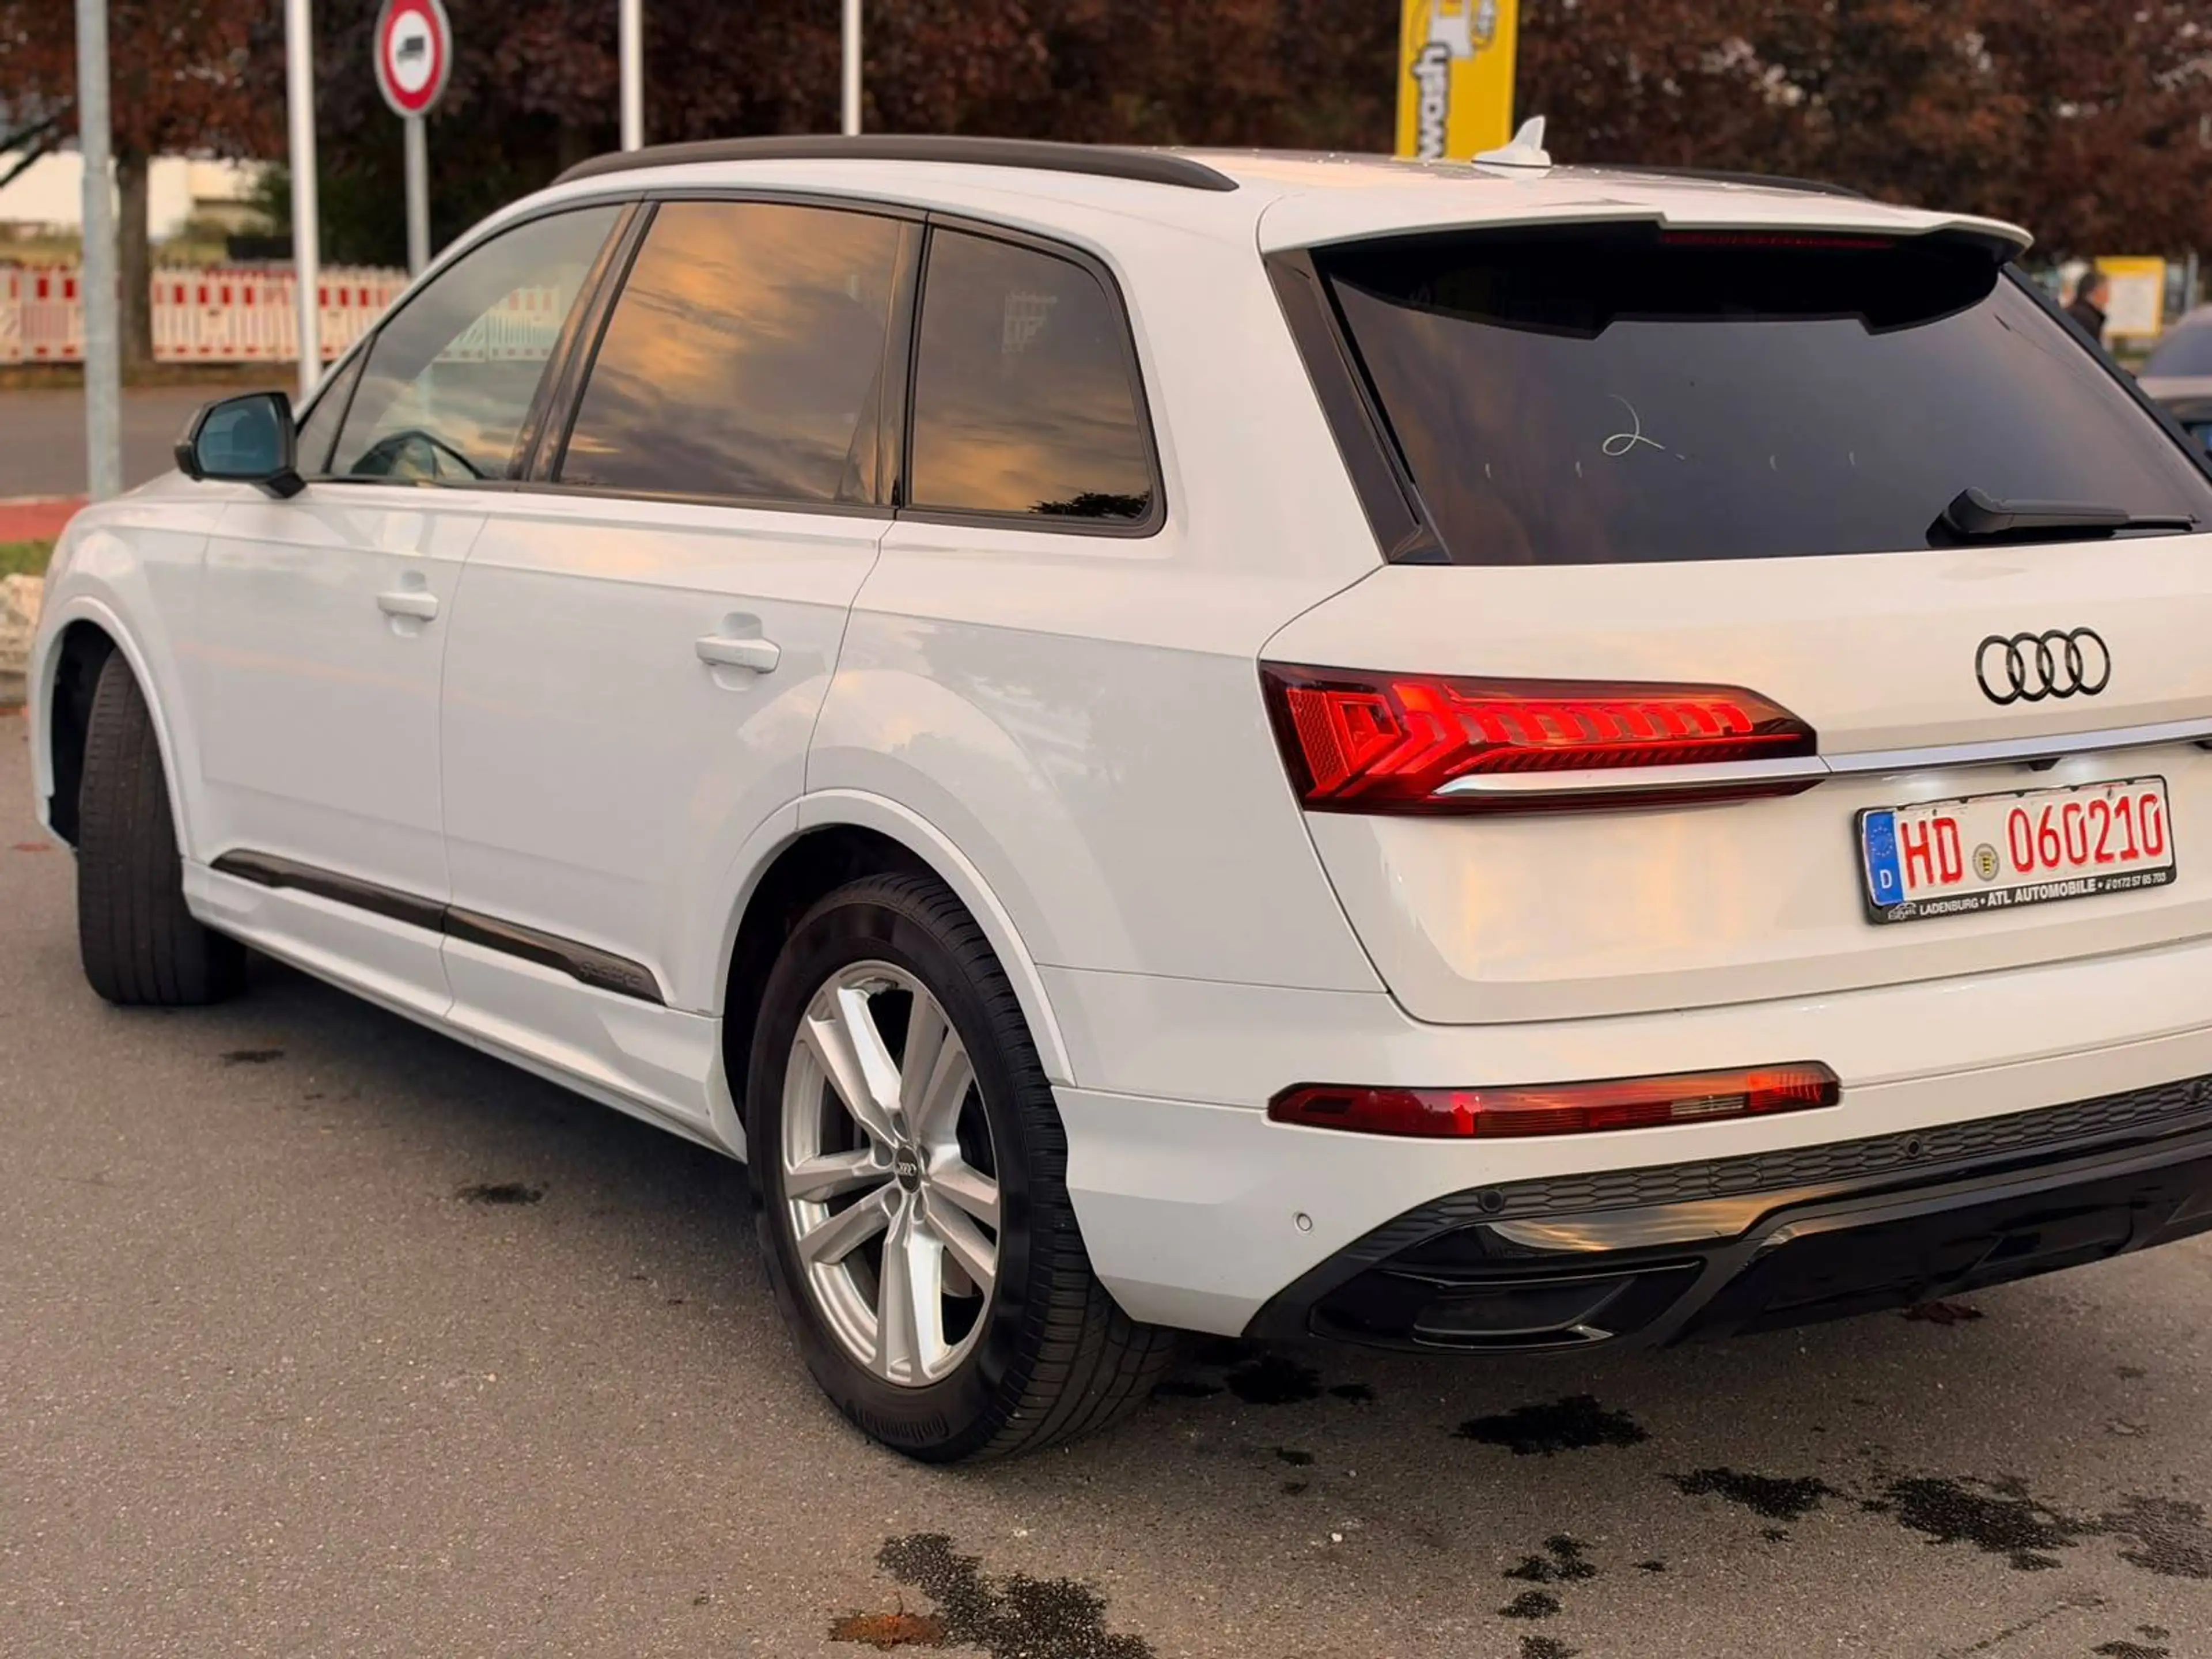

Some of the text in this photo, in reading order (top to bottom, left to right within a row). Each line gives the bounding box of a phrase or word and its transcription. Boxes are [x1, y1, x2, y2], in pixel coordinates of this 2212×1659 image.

[1901, 793, 2164, 889] HD 060210
[1880, 869, 1892, 889] D
[1919, 898, 1979, 916] LADENBURG
[1987, 890, 2012, 907] ATL
[2014, 878, 2096, 903] AUTOMOBILE
